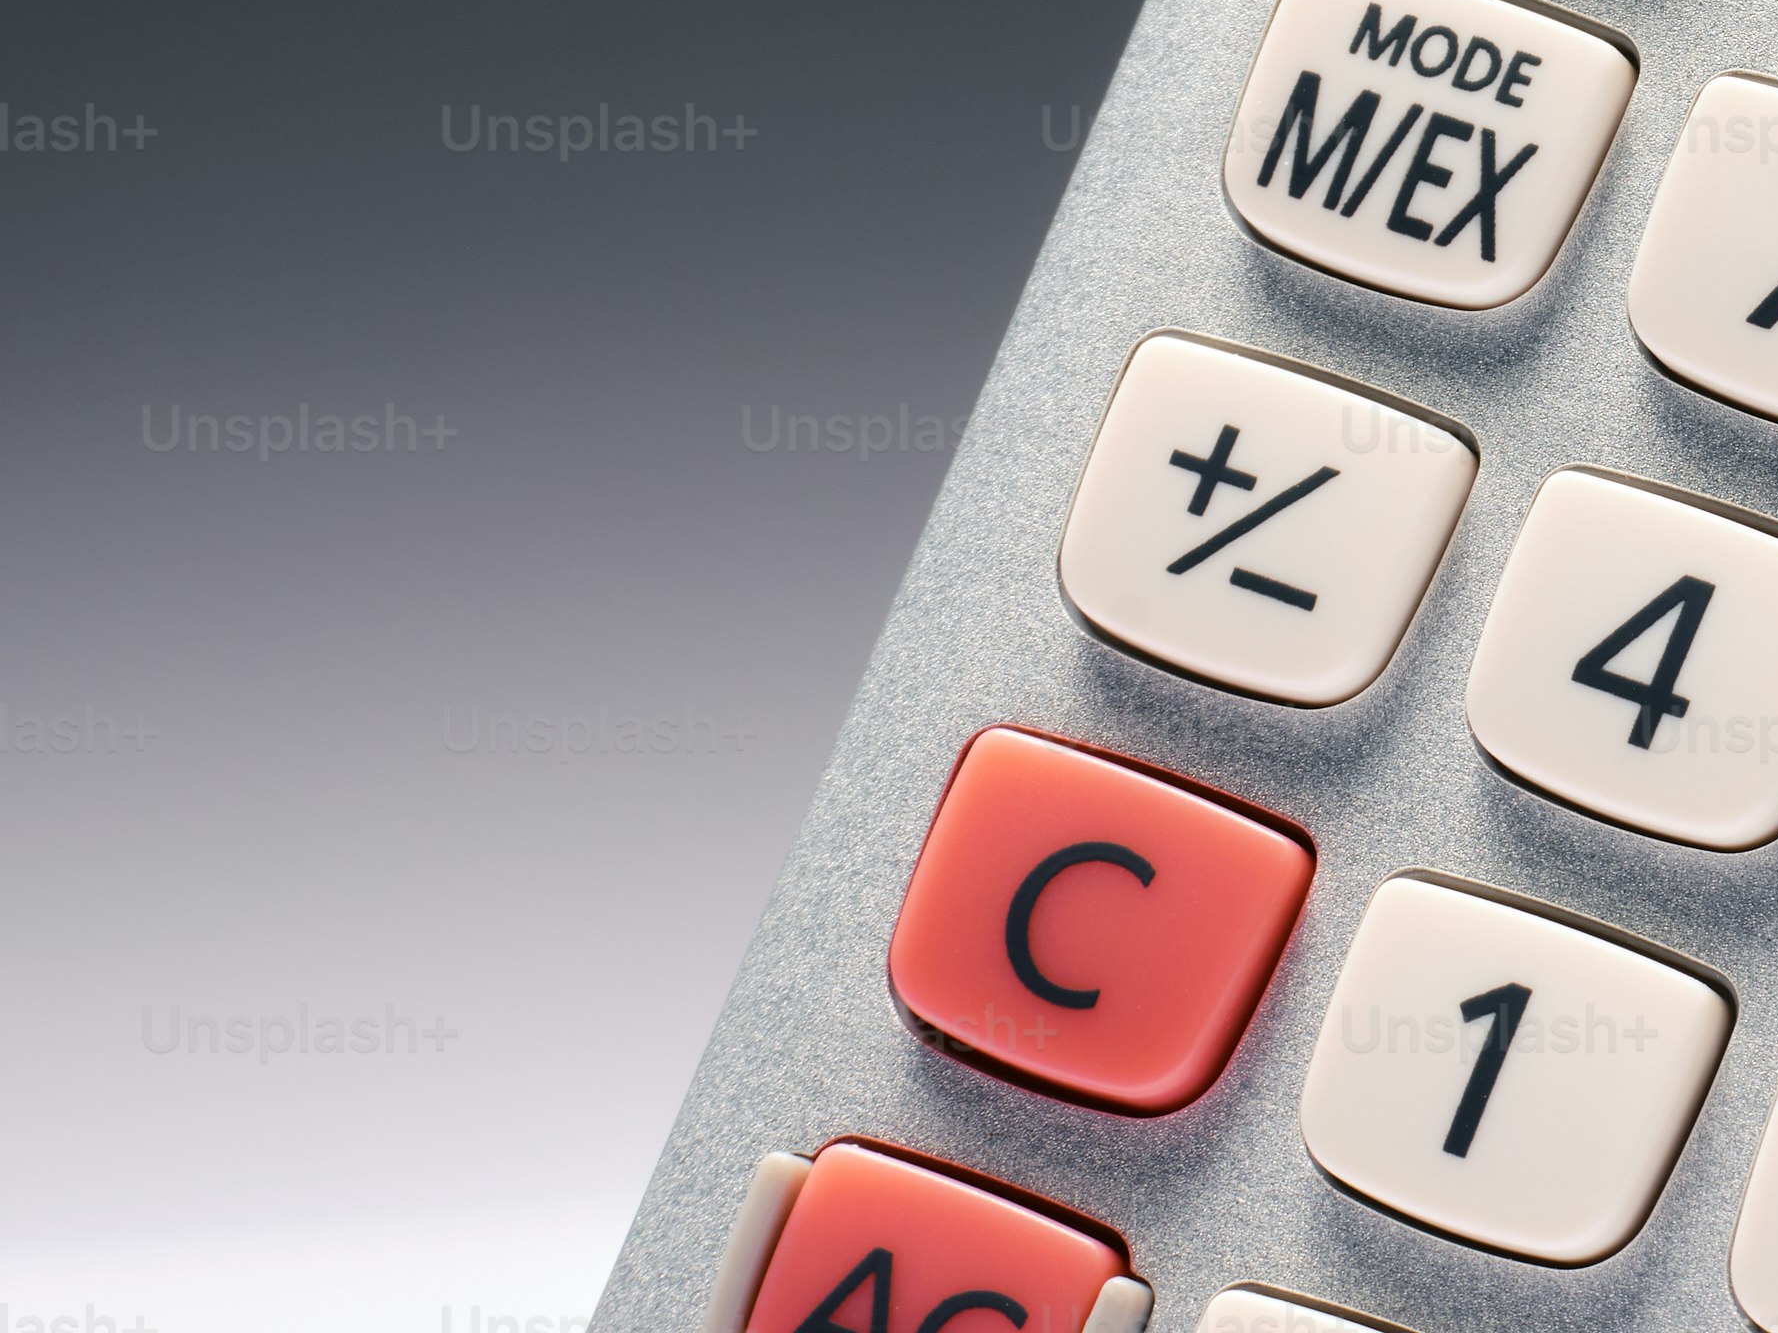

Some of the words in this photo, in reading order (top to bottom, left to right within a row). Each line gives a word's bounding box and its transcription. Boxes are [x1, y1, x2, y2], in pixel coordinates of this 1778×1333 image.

[1348, 3, 1543, 109] MODE
[1256, 70, 1540, 264] M/EX
[1571, 575, 1715, 750] 4
[1005, 842, 1155, 1010] C
[1443, 983, 1532, 1159] 1
[795, 1248, 1027, 1333] A
